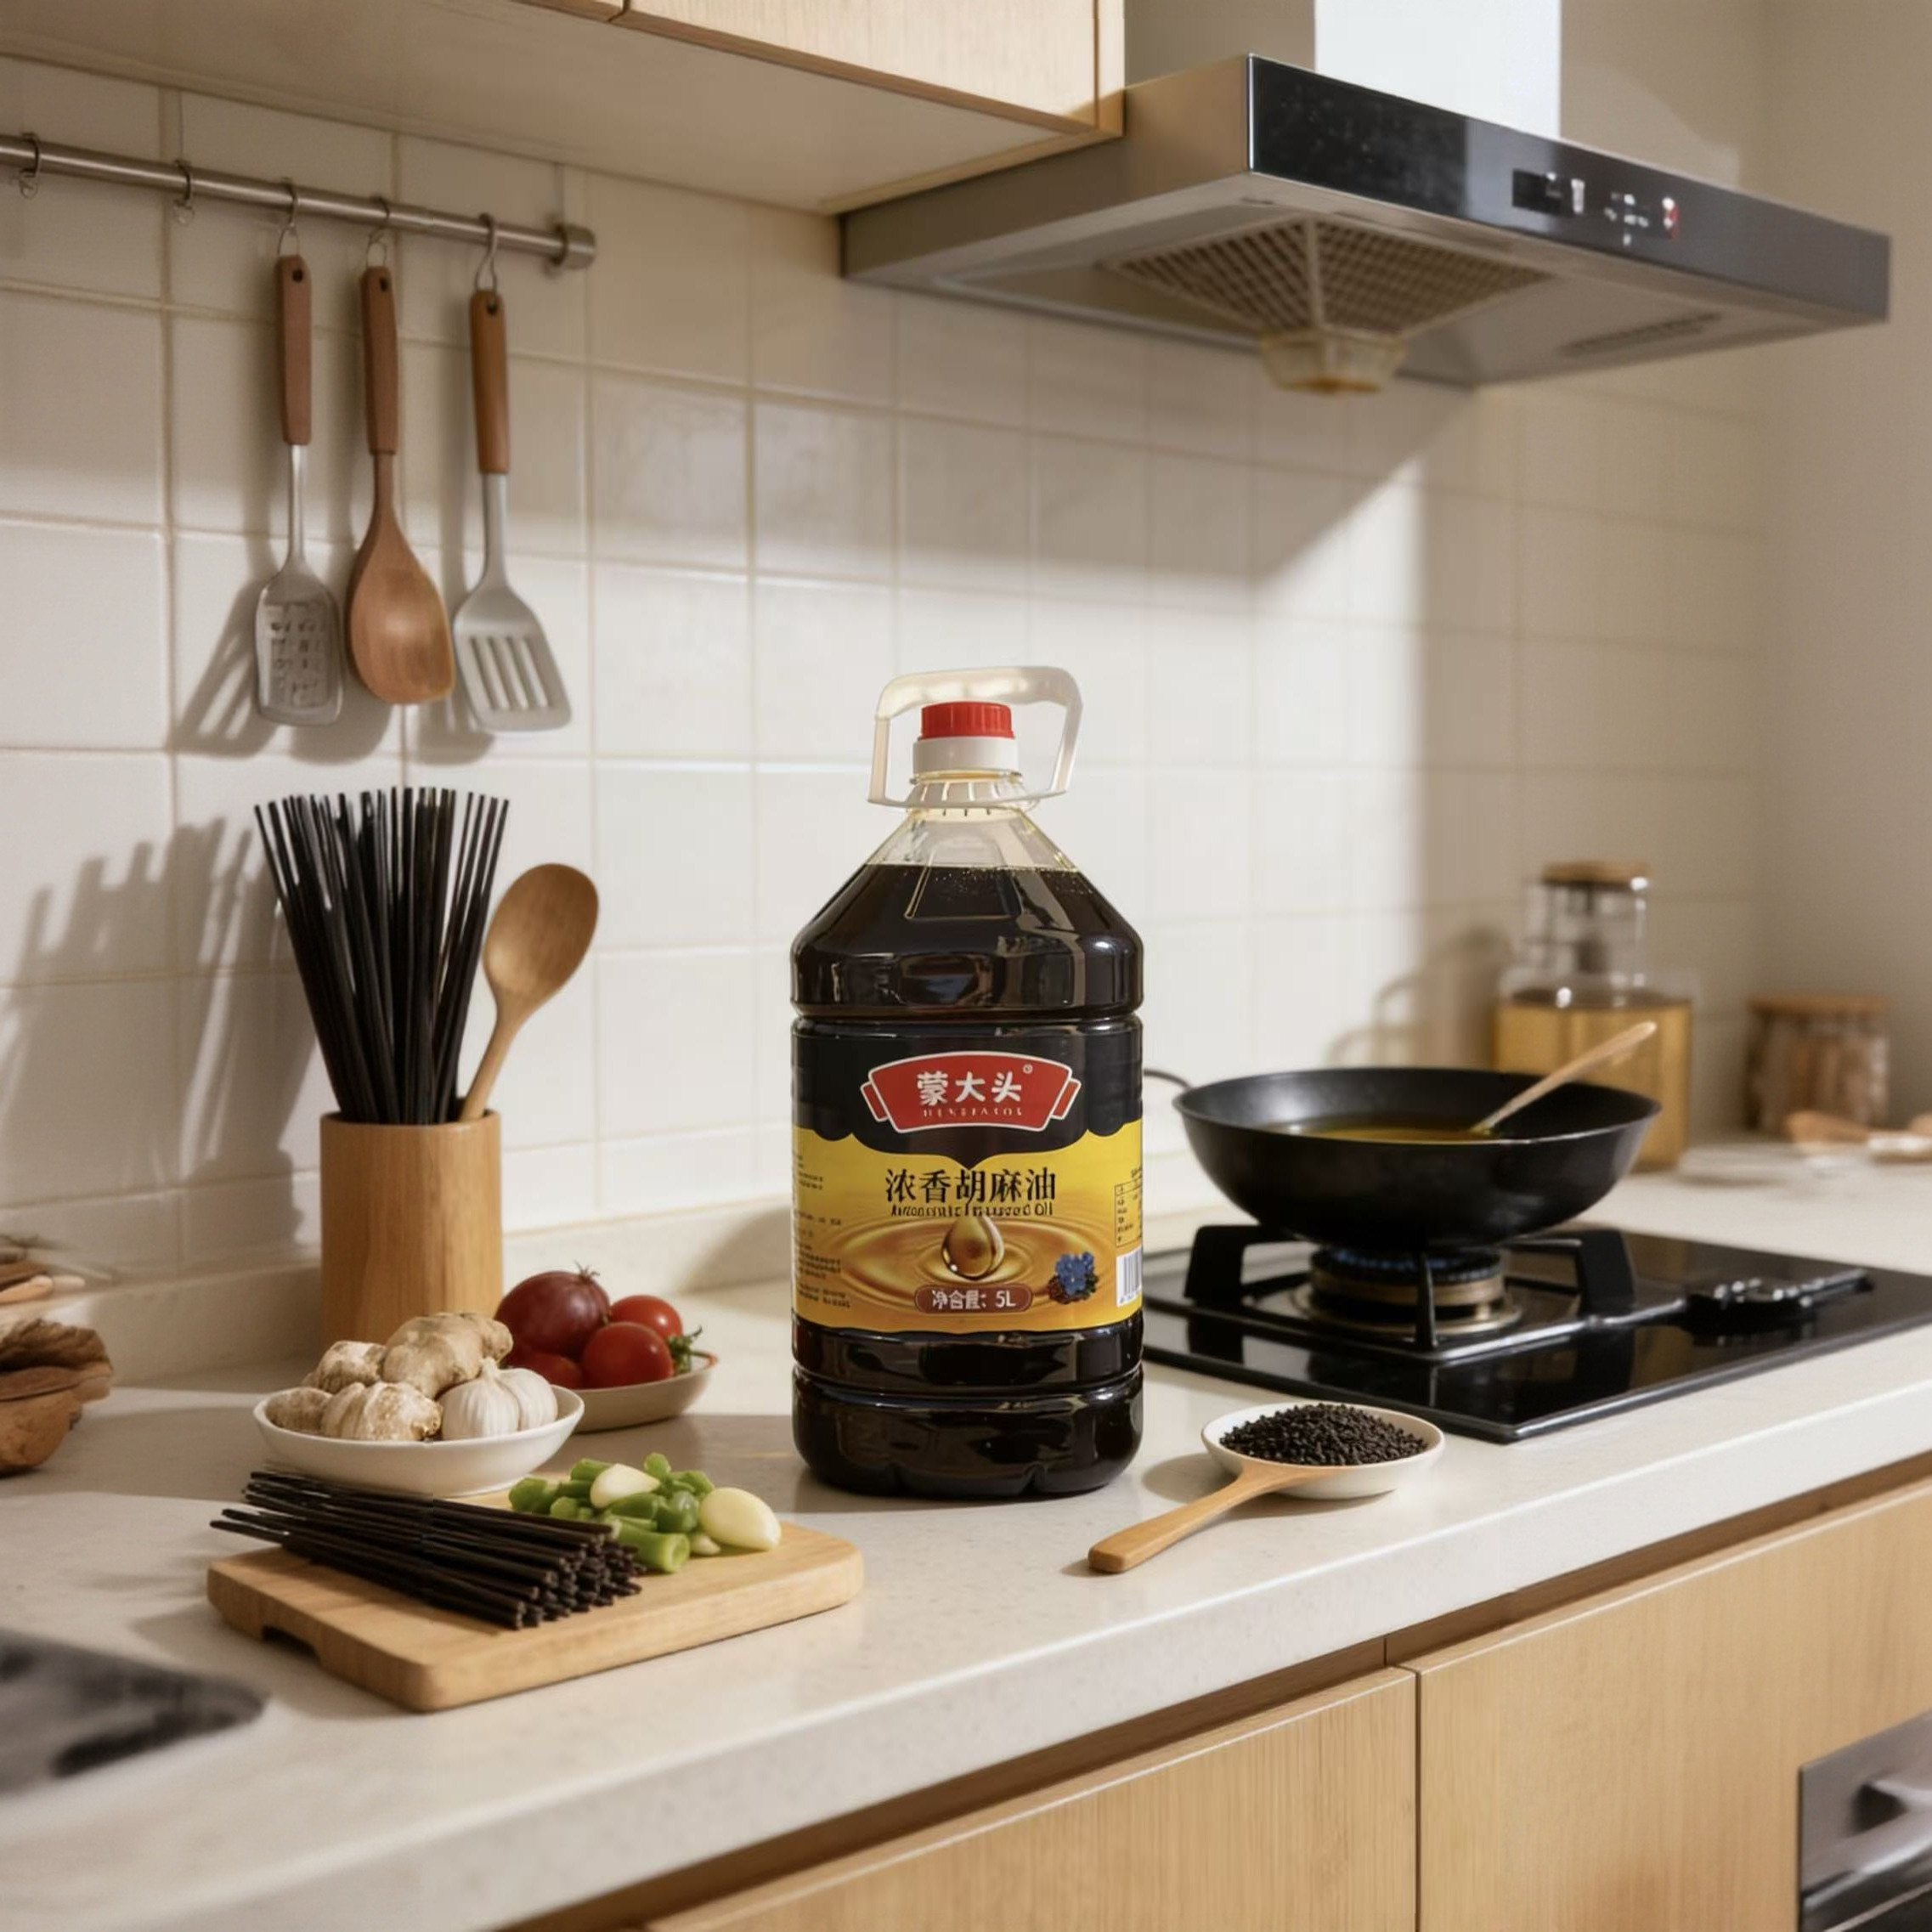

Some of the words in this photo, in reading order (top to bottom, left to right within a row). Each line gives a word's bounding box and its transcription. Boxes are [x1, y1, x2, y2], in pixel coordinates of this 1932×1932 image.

[917, 1071, 1022, 1106] 蒙大头
[884, 1167, 1056, 1204] 浓香胡麻油
